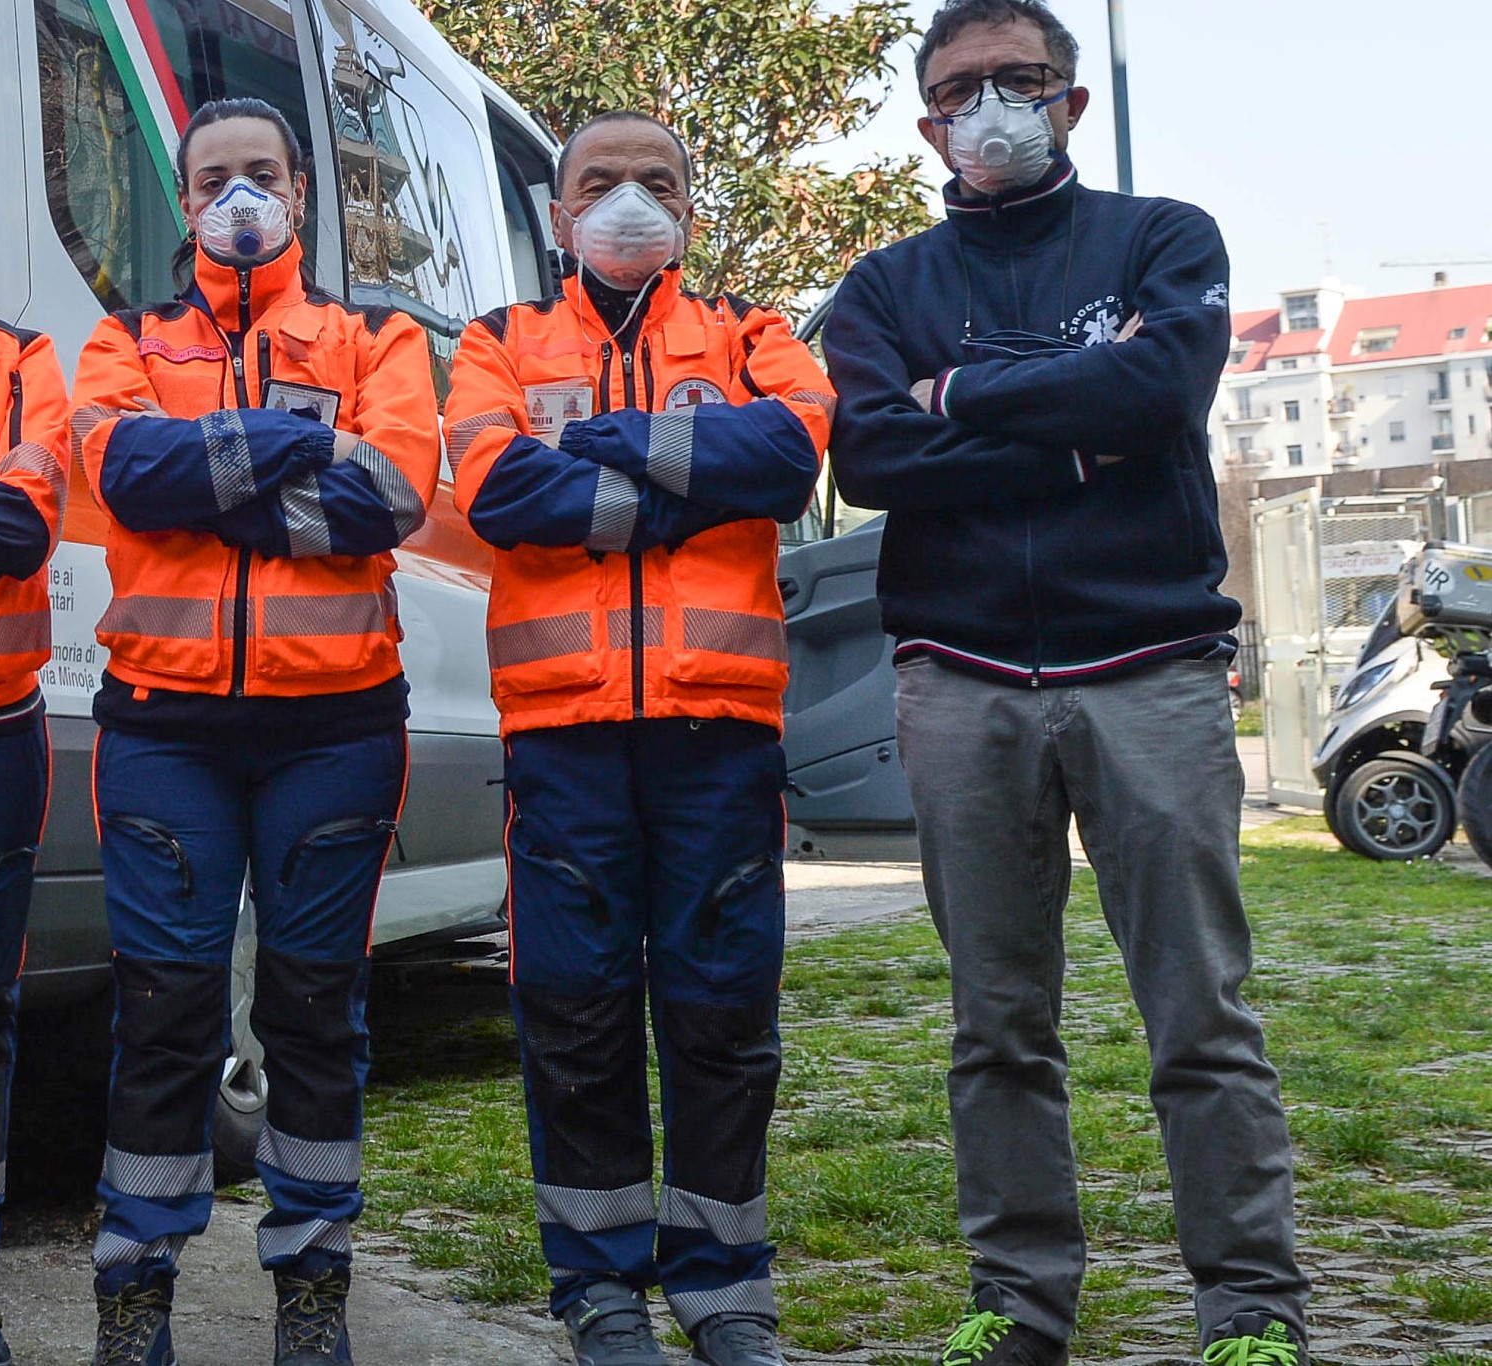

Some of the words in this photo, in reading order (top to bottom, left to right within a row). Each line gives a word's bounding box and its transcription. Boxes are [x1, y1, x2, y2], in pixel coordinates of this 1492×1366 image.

[1069, 300, 1102, 335] CROCE
[671, 384, 694, 401] CROCE
[695, 383, 719, 400] D'ORO
[63, 567, 73, 586] ai
[85, 643, 96, 664] di
[58, 666, 95, 692] Minoja
